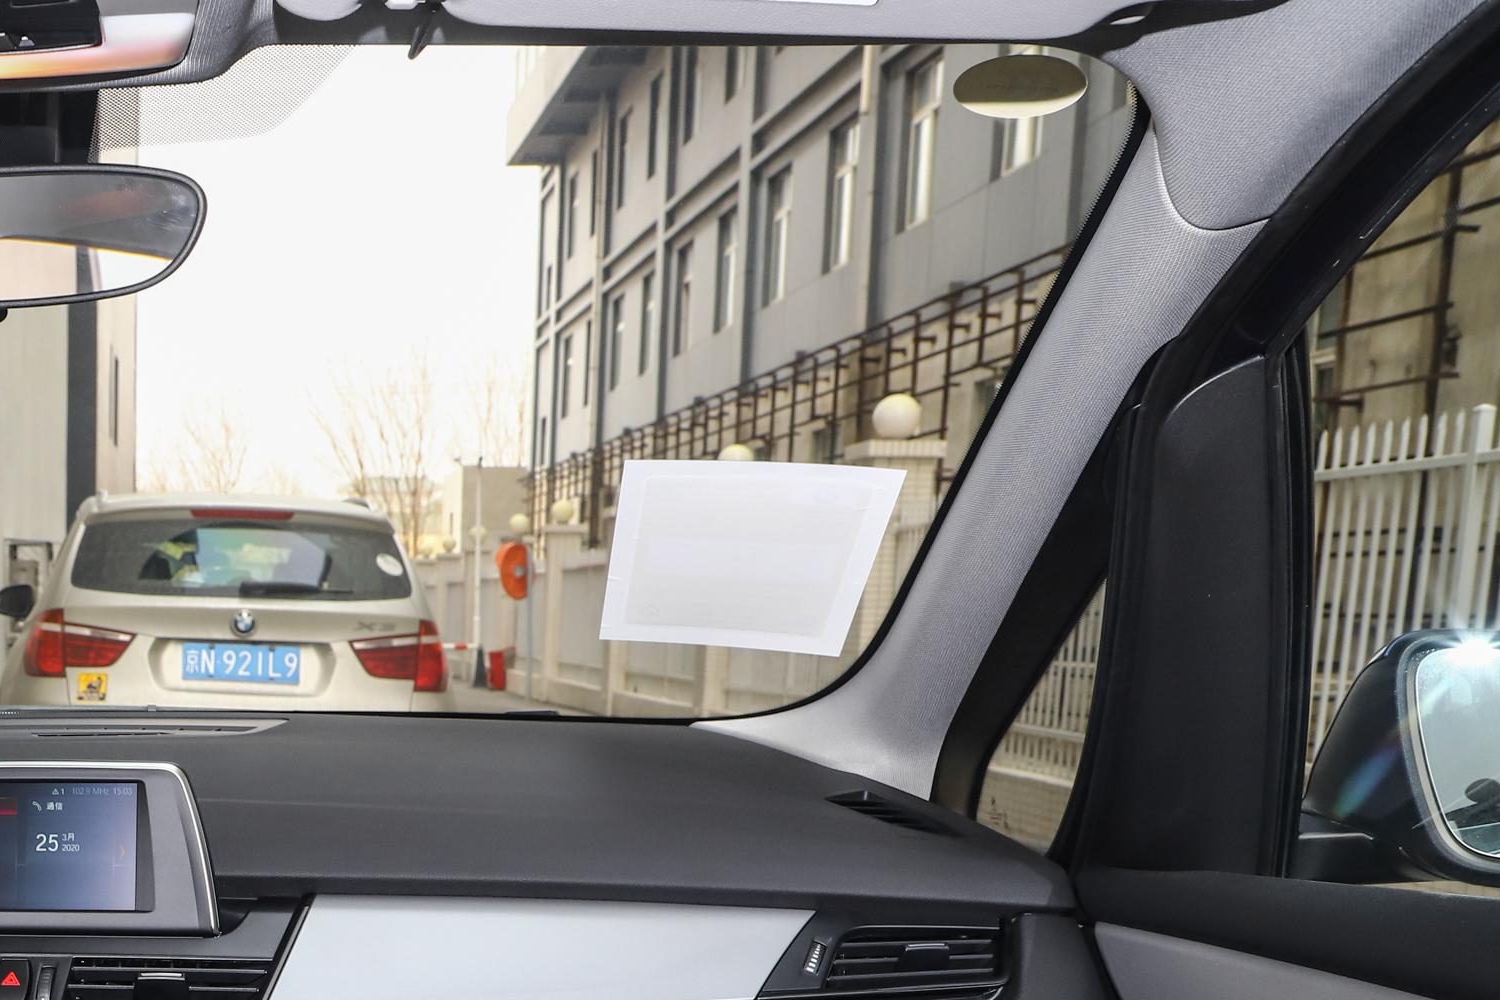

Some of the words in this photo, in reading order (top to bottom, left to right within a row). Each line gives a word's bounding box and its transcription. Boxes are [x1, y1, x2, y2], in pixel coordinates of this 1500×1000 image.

[62, 833, 75, 842] 3月
[35, 833, 59, 852] 25
[61, 844, 80, 852] 2020
